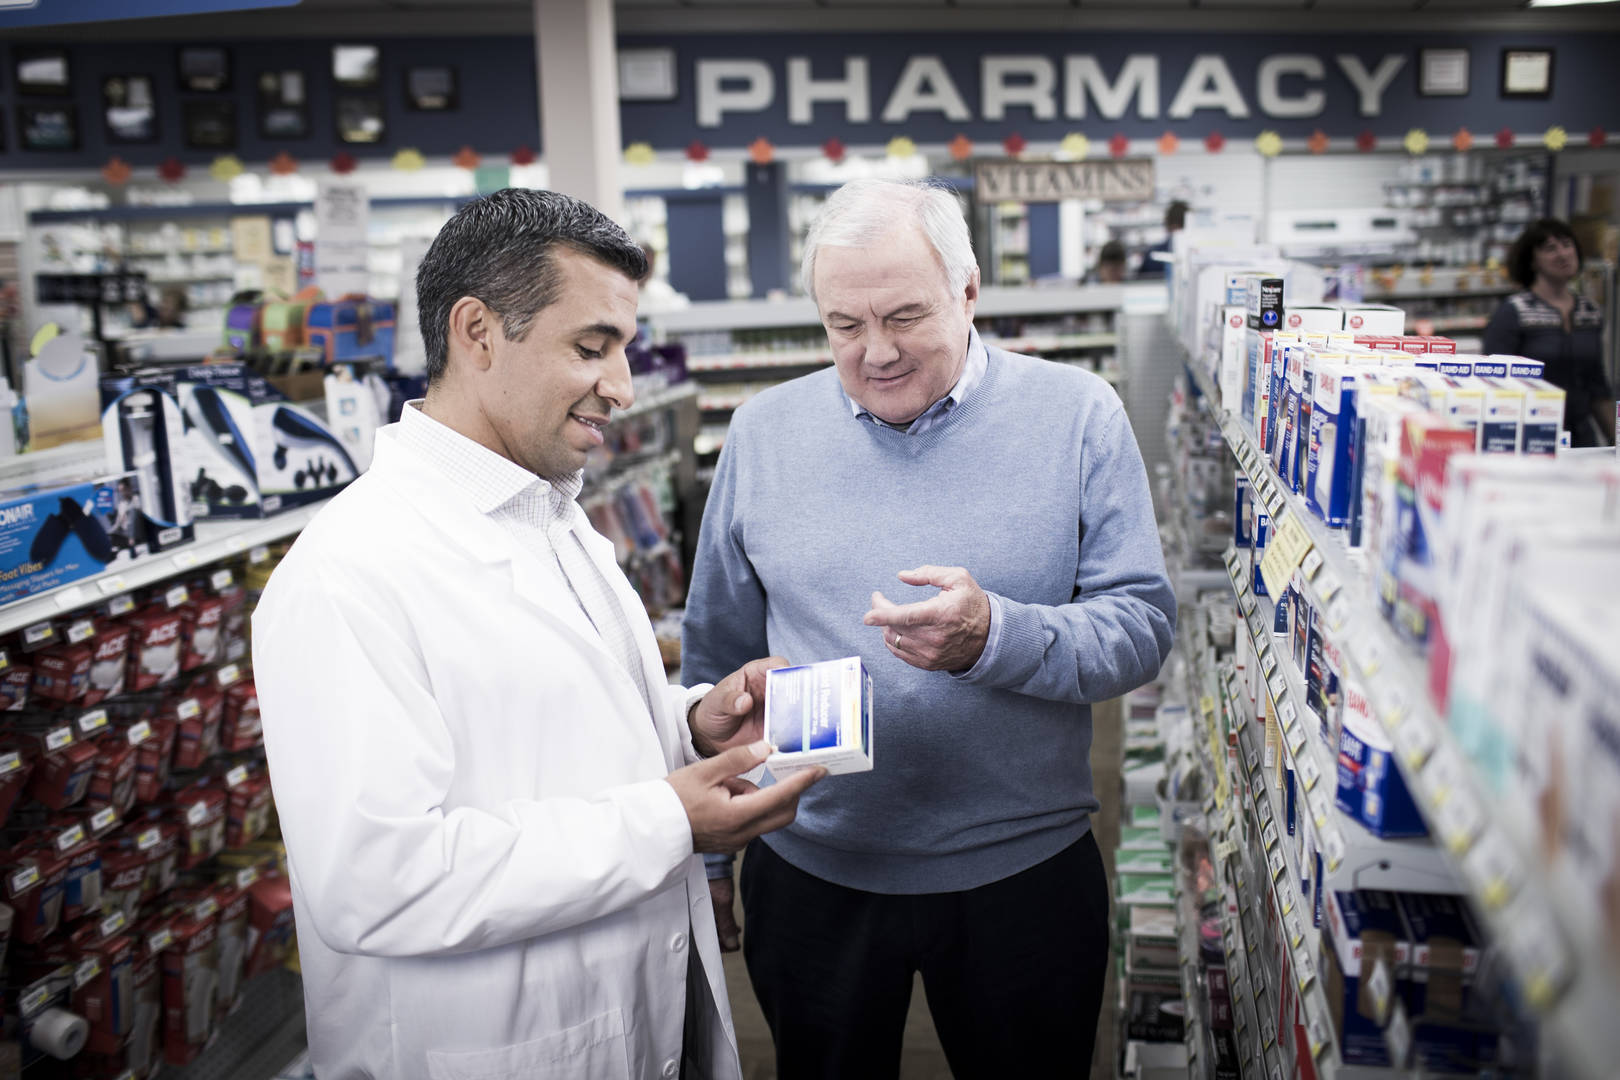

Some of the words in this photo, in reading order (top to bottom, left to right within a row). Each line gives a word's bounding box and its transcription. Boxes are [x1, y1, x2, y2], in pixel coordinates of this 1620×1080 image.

[695, 53, 1406, 129] PHARMACY
[979, 163, 1147, 203] VITAMINS
[1439, 366, 1470, 375] BAND-AID
[1474, 366, 1505, 375] BAND-AID
[1511, 366, 1543, 376] BAND-AID
[19, 562, 43, 576] Vibes
[198, 605, 222, 624] ACE
[145, 620, 180, 644] ACE
[95, 634, 128, 658] ACE
[42, 658, 66, 670] ACE
[74, 659, 91, 673] ACE
[6, 671, 31, 683] ACE
[71, 851, 98, 867] ACE
[111, 865, 145, 889] ACE
[188, 924, 215, 951] ACE
